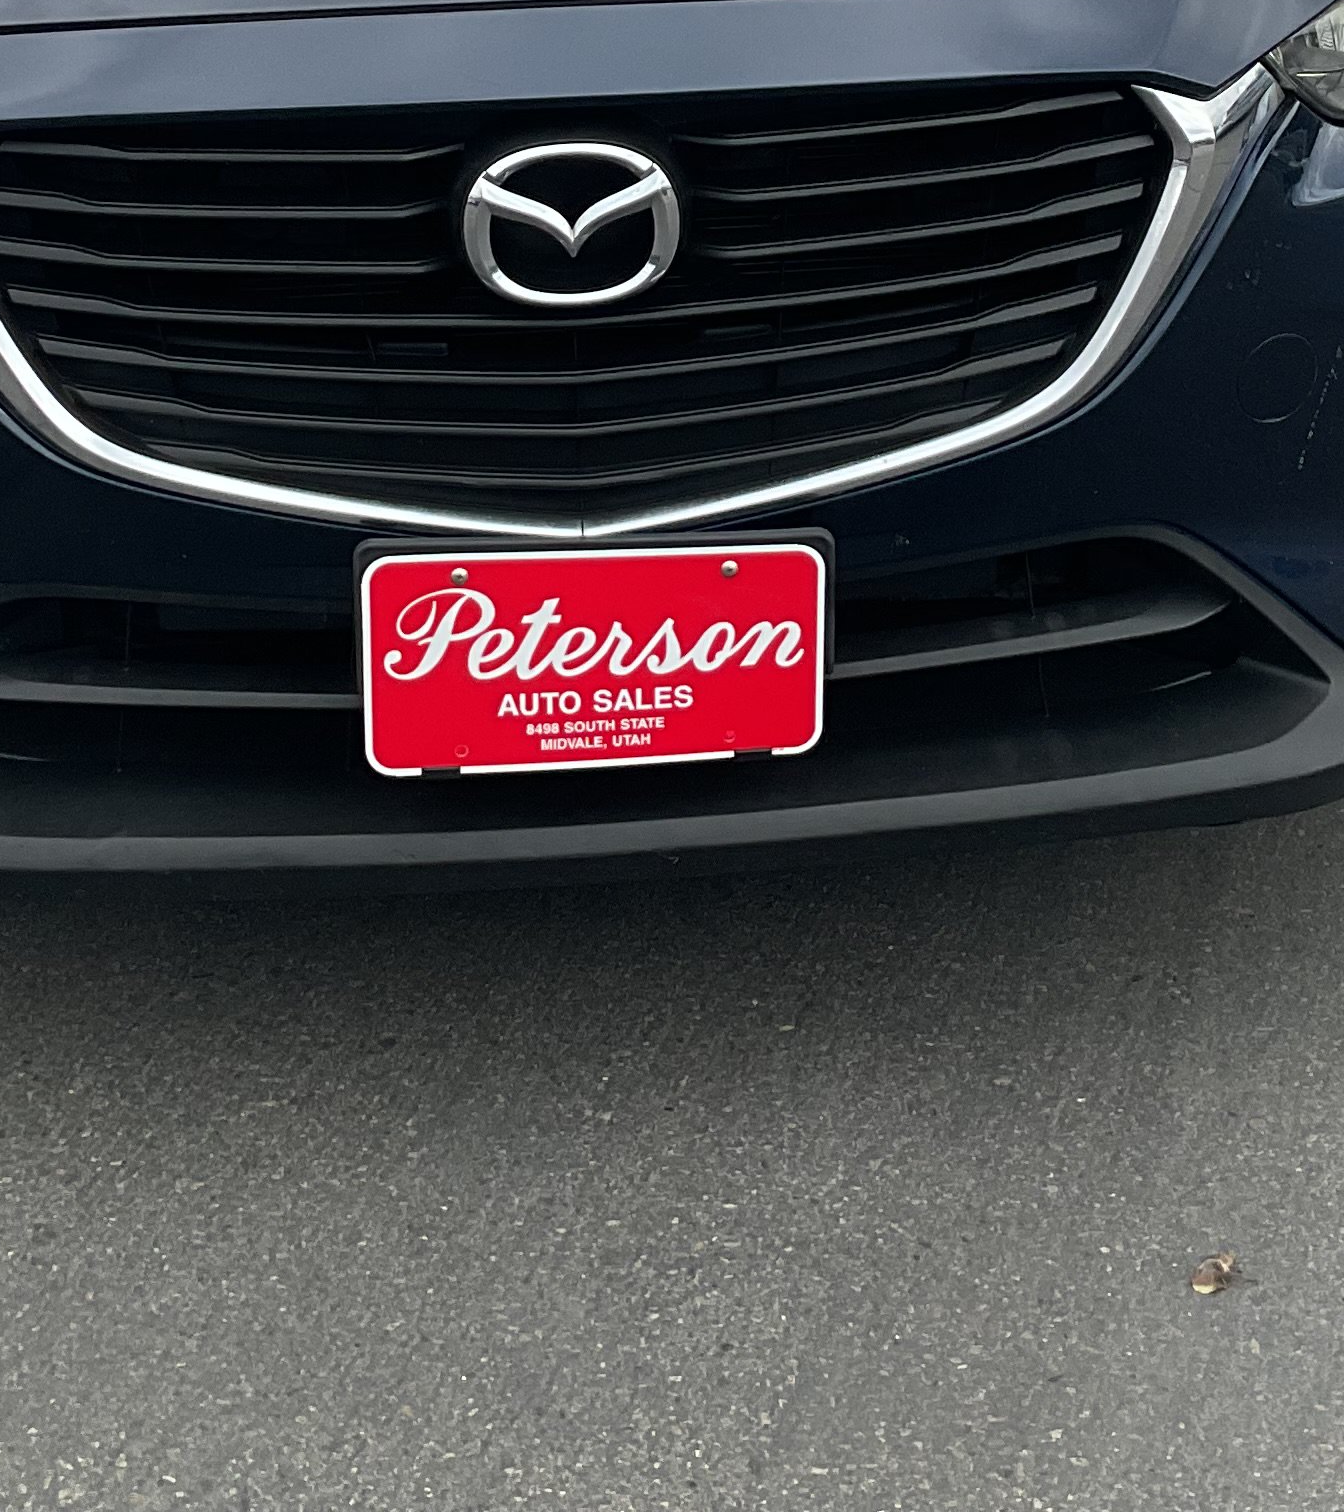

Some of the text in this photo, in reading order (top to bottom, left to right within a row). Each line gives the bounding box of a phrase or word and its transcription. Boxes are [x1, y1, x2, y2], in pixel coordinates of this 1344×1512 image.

[383, 587, 805, 681] Peterson
[497, 685, 694, 717] AUTO SALES
[526, 716, 665, 736] 8498 SOUTH STATE
[540, 733, 652, 751] MIDVALE, UTAH
